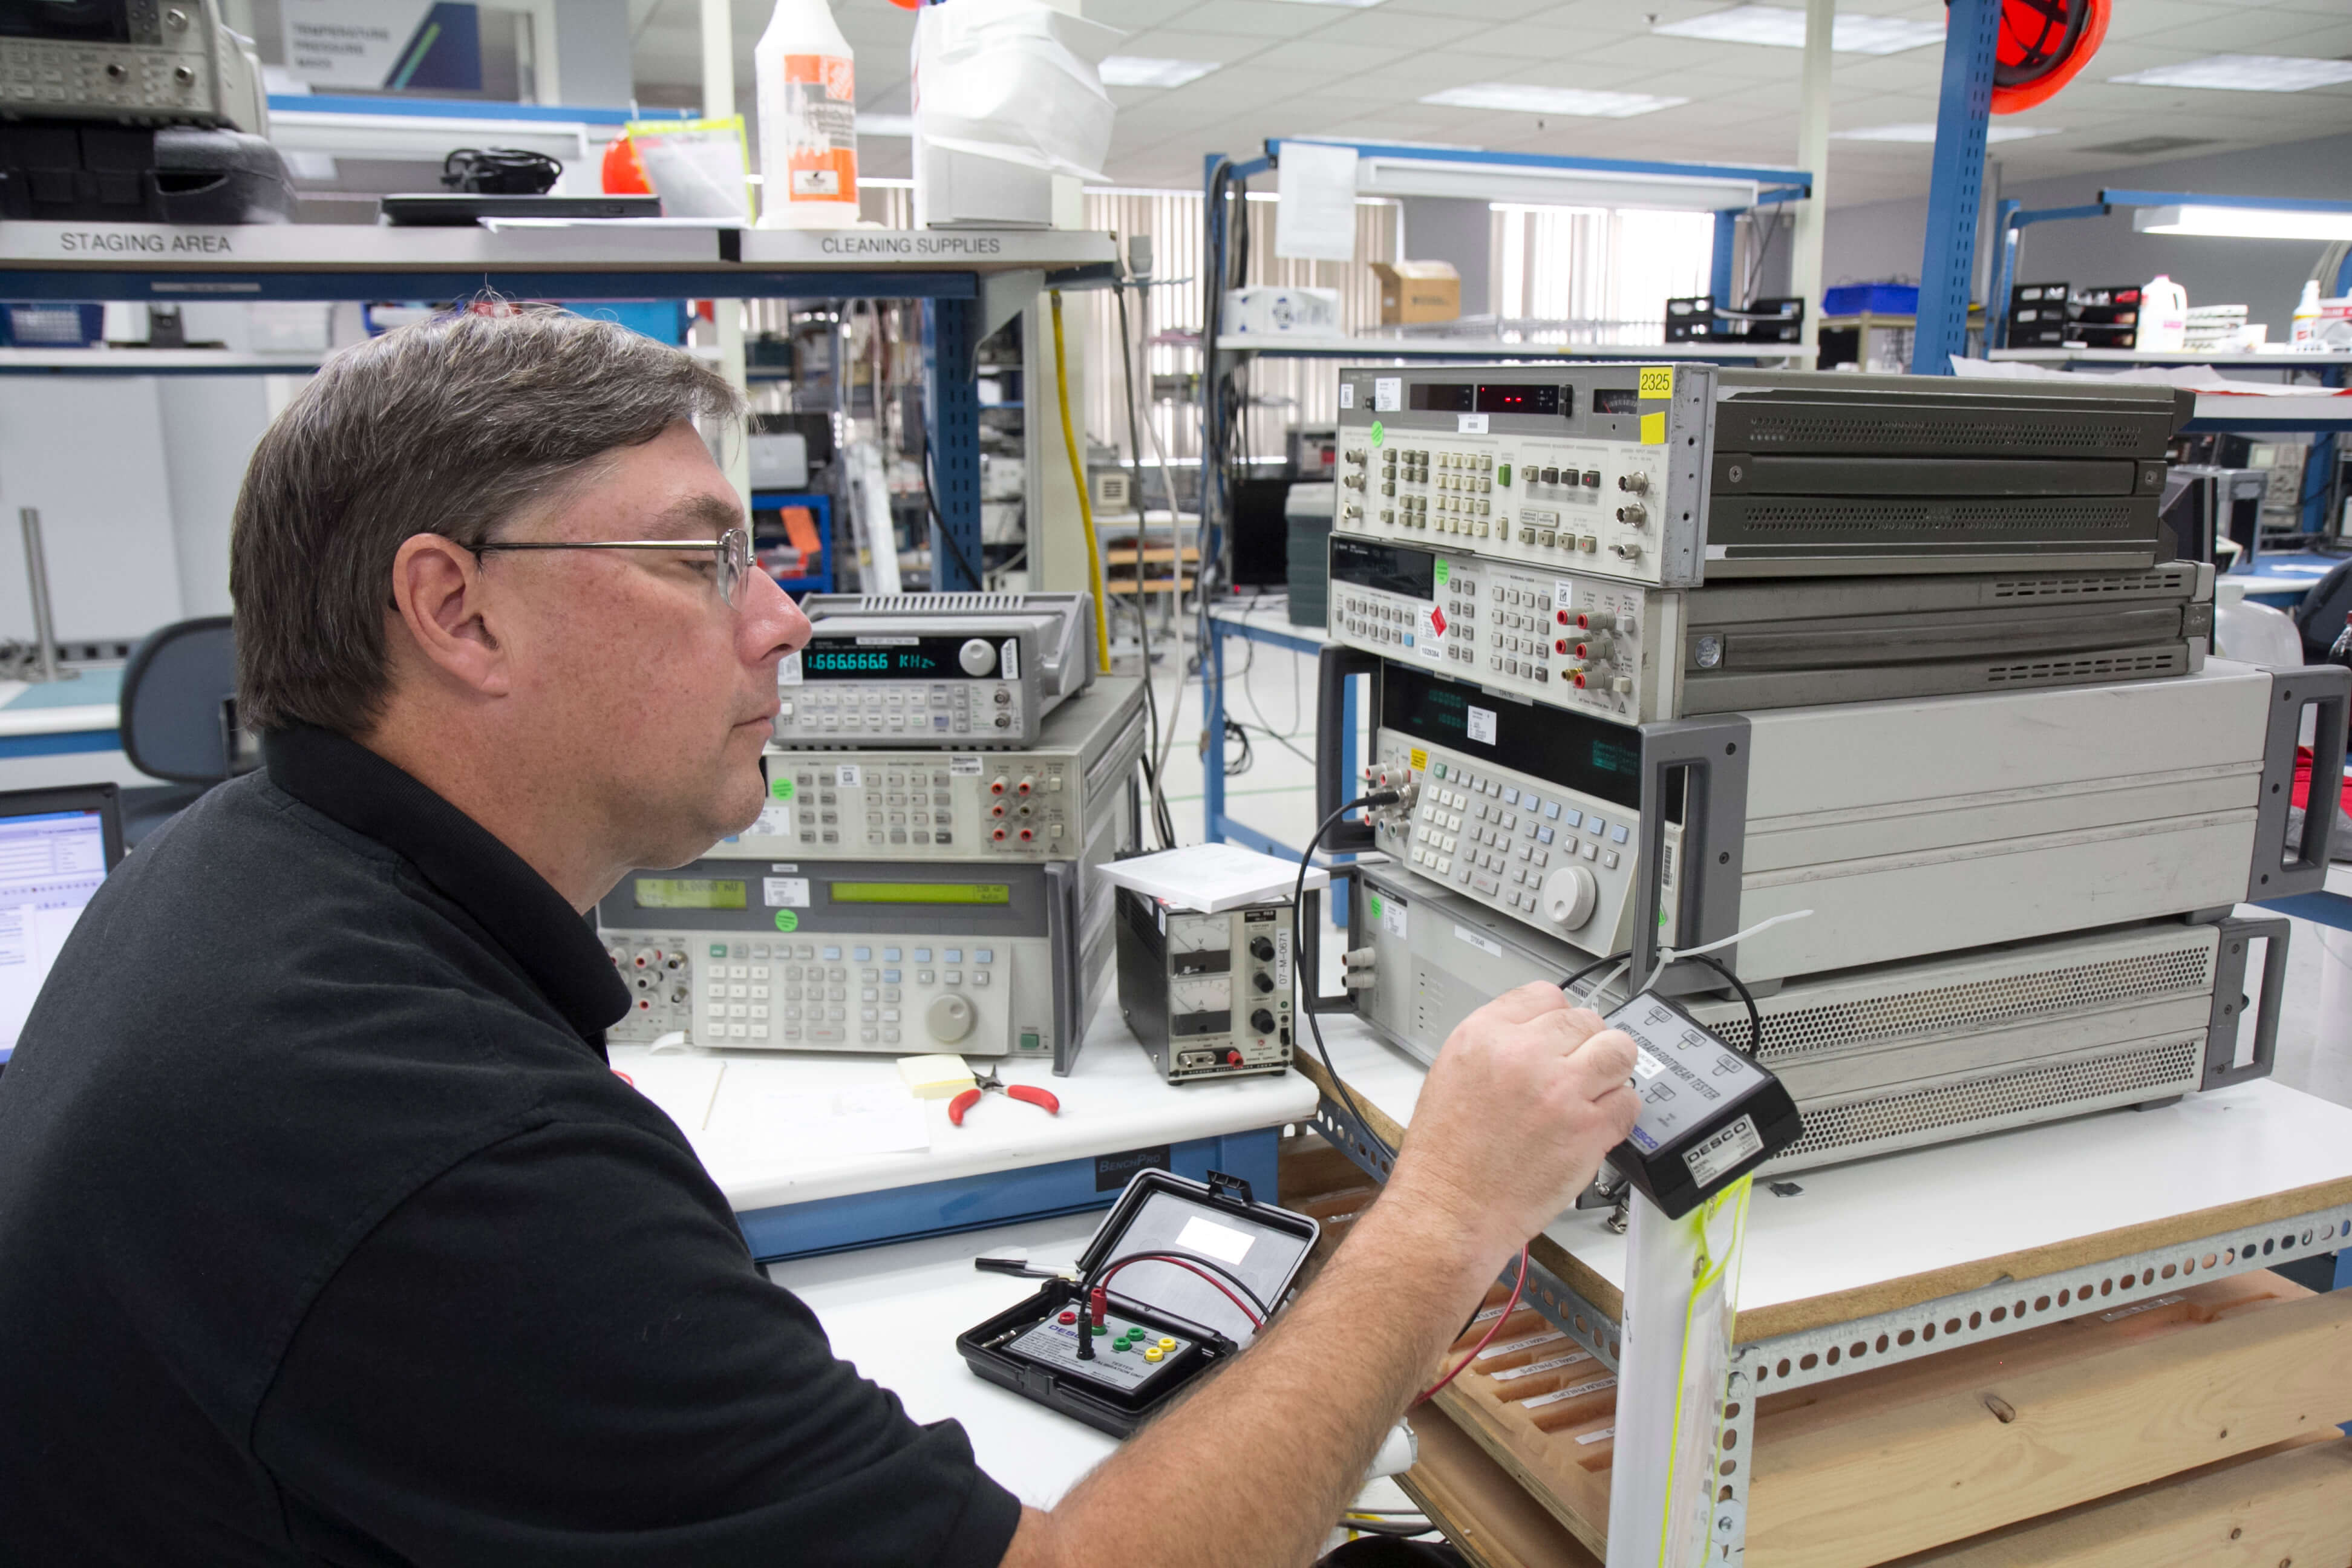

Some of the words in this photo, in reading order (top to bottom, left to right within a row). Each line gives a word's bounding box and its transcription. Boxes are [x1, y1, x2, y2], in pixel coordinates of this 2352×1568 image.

[60, 232, 164, 253] STAGING
[171, 235, 232, 253] AREA
[822, 237, 912, 253] CLEANING
[916, 237, 1001, 254] SUPPLIES
[1641, 373, 1670, 391] 2325
[1614, 1021, 1639, 1040] WRIST
[1690, 1078, 1721, 1100] TESTER
[1633, 1124, 1659, 1149] ESCO
[1687, 1122, 1746, 1163] DESCO
[1111, 1361, 1134, 1370] TESTER
[1554, 1355, 1577, 1364] SMALL
[1130, 1370, 1145, 1379] UNIT
[1520, 1363, 1553, 1374] PHILLIPS
[1586, 1378, 1616, 1390] MEDIUM
[1552, 1387, 1586, 1399] PHILLIPS
